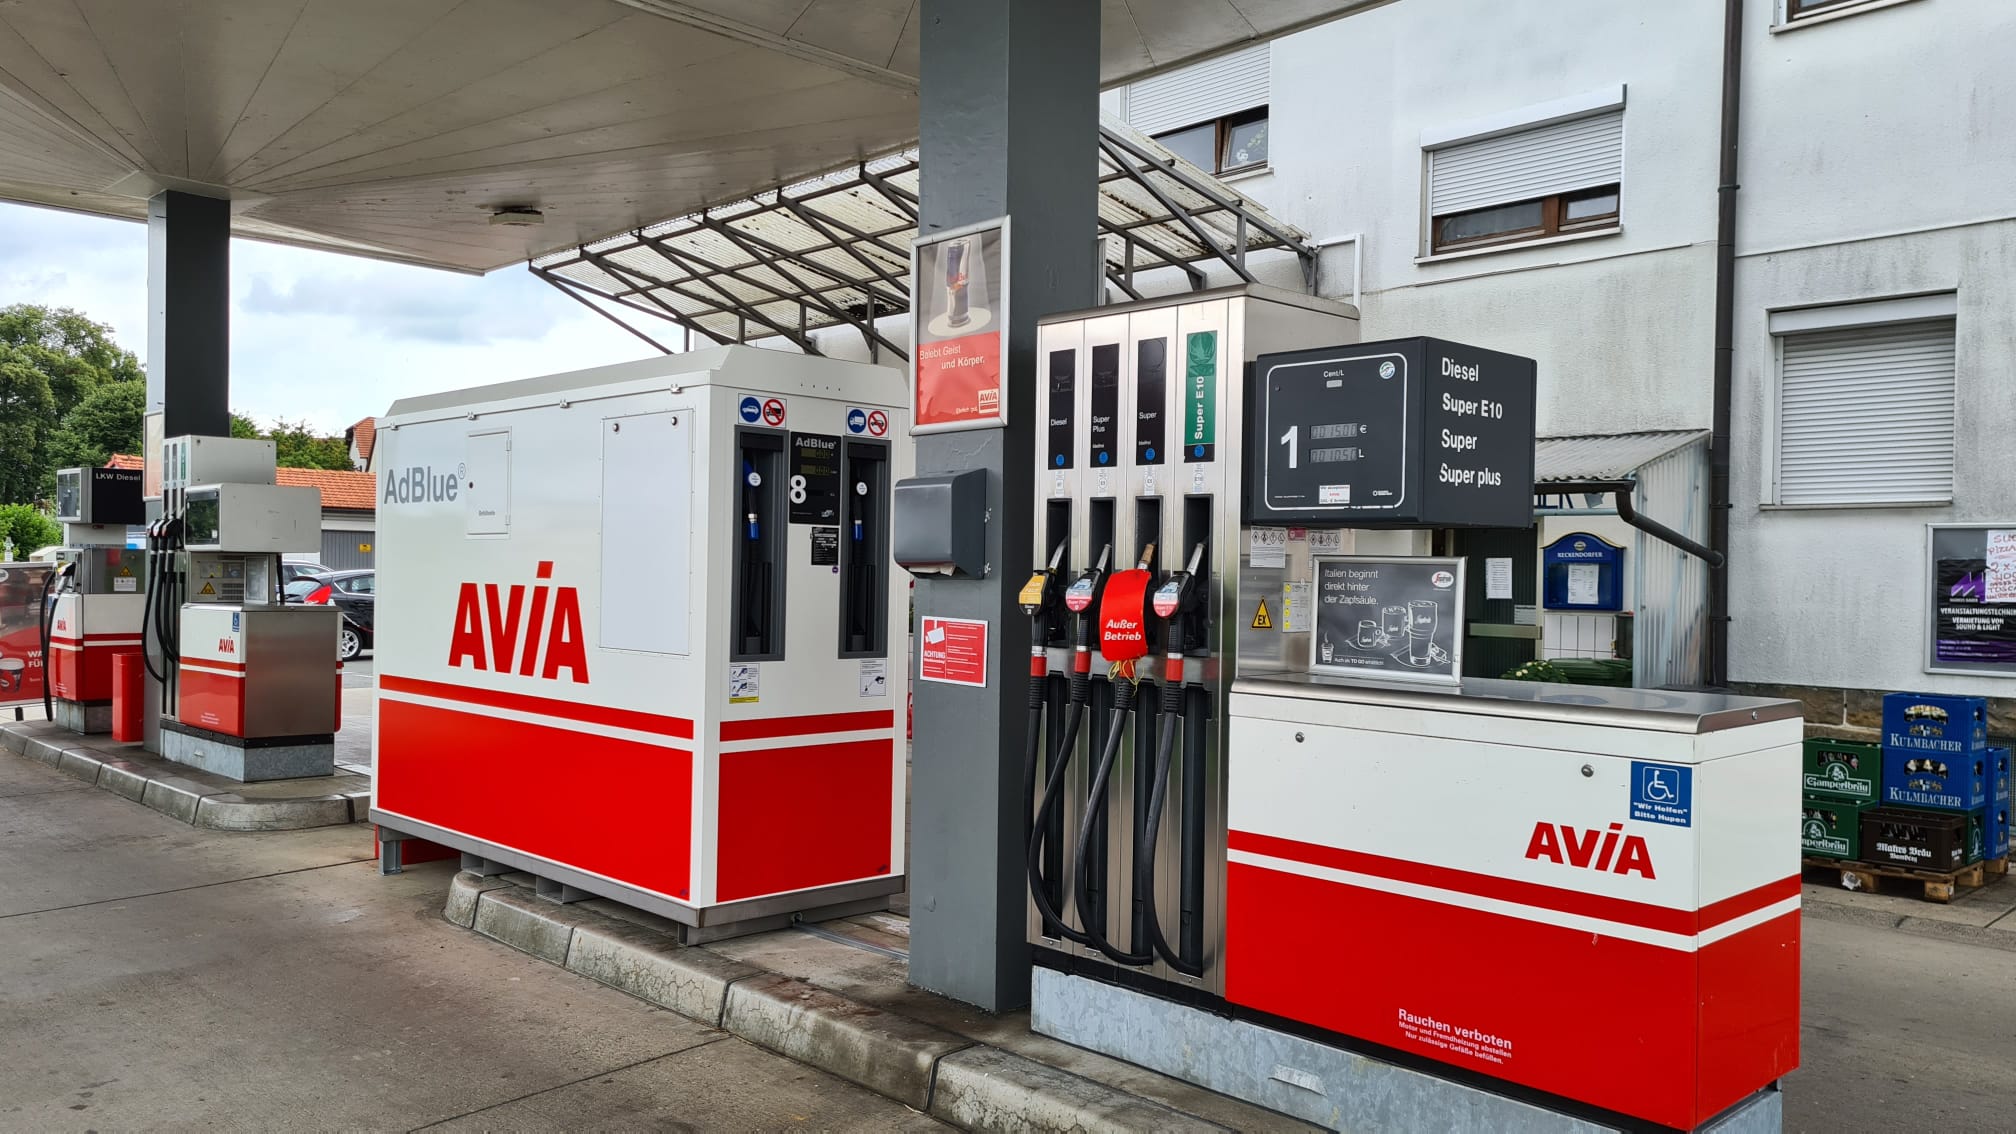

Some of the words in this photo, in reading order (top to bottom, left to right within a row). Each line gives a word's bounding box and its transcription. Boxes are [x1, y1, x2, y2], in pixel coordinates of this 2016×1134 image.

[919, 349, 941, 360] Belebt
[943, 344, 961, 356] Geist
[941, 361, 955, 369] und
[957, 356, 984, 368] Körper.
[1323, 369, 1345, 378] Cent/L
[1441, 357, 1479, 382] Diesel
[1196, 375, 1205, 399] E10
[1442, 392, 1478, 416] Super
[1481, 399, 1503, 419] E10
[1050, 417, 1067, 426] Diesel
[1093, 415, 1110, 424] Super
[1138, 411, 1157, 421] Super
[1194, 403, 1205, 440] Super
[1092, 425, 1106, 433] Plus
[1359, 424, 1368, 434] €
[1281, 425, 1298, 469] 1
[1441, 428, 1478, 453] Super
[1358, 448, 1365, 458] L
[116, 473, 141, 481] Diesel
[1439, 462, 1476, 487] Super
[1477, 467, 1502, 489] plus
[790, 474, 807, 505] 8
[1324, 568, 1347, 579] Italien
[1348, 569, 1379, 581] beginnt
[1324, 581, 1345, 592] direkt
[1347, 582, 1370, 592] hinter
[1324, 594, 1338, 604] der
[1339, 594, 1379, 607] Zapfsäule.
[1106, 619, 1138, 629] Außer
[1258, 614, 1266, 625] EX
[1952, 616, 1990, 624] VERMIETUNG
[1991, 617, 2004, 625] VON
[1104, 631, 1142, 641] Betrieb
[1890, 733, 1962, 752] KULMBACHER
[1889, 787, 1962, 807] KULMBACHER
[1634, 810, 1656, 819] Bitte
[1657, 814, 1687, 824] Hupen
[1908, 846, 1932, 858] Bräu
[1399, 1008, 1451, 1033] Rauchen
[1454, 1026, 1512, 1050] verboten
[1399, 1021, 1418, 1032] Motor
[1419, 1028, 1432, 1036] und
[1433, 1030, 1480, 1050] Fremdheizung
[1480, 1045, 1512, 1058] abstellen
[1405, 1031, 1417, 1040] Nur
[1418, 1035, 1448, 1049] zulässige
[1449, 1043, 1474, 1056] Gefäße
[1474, 1051, 1504, 1065] befüllen.
